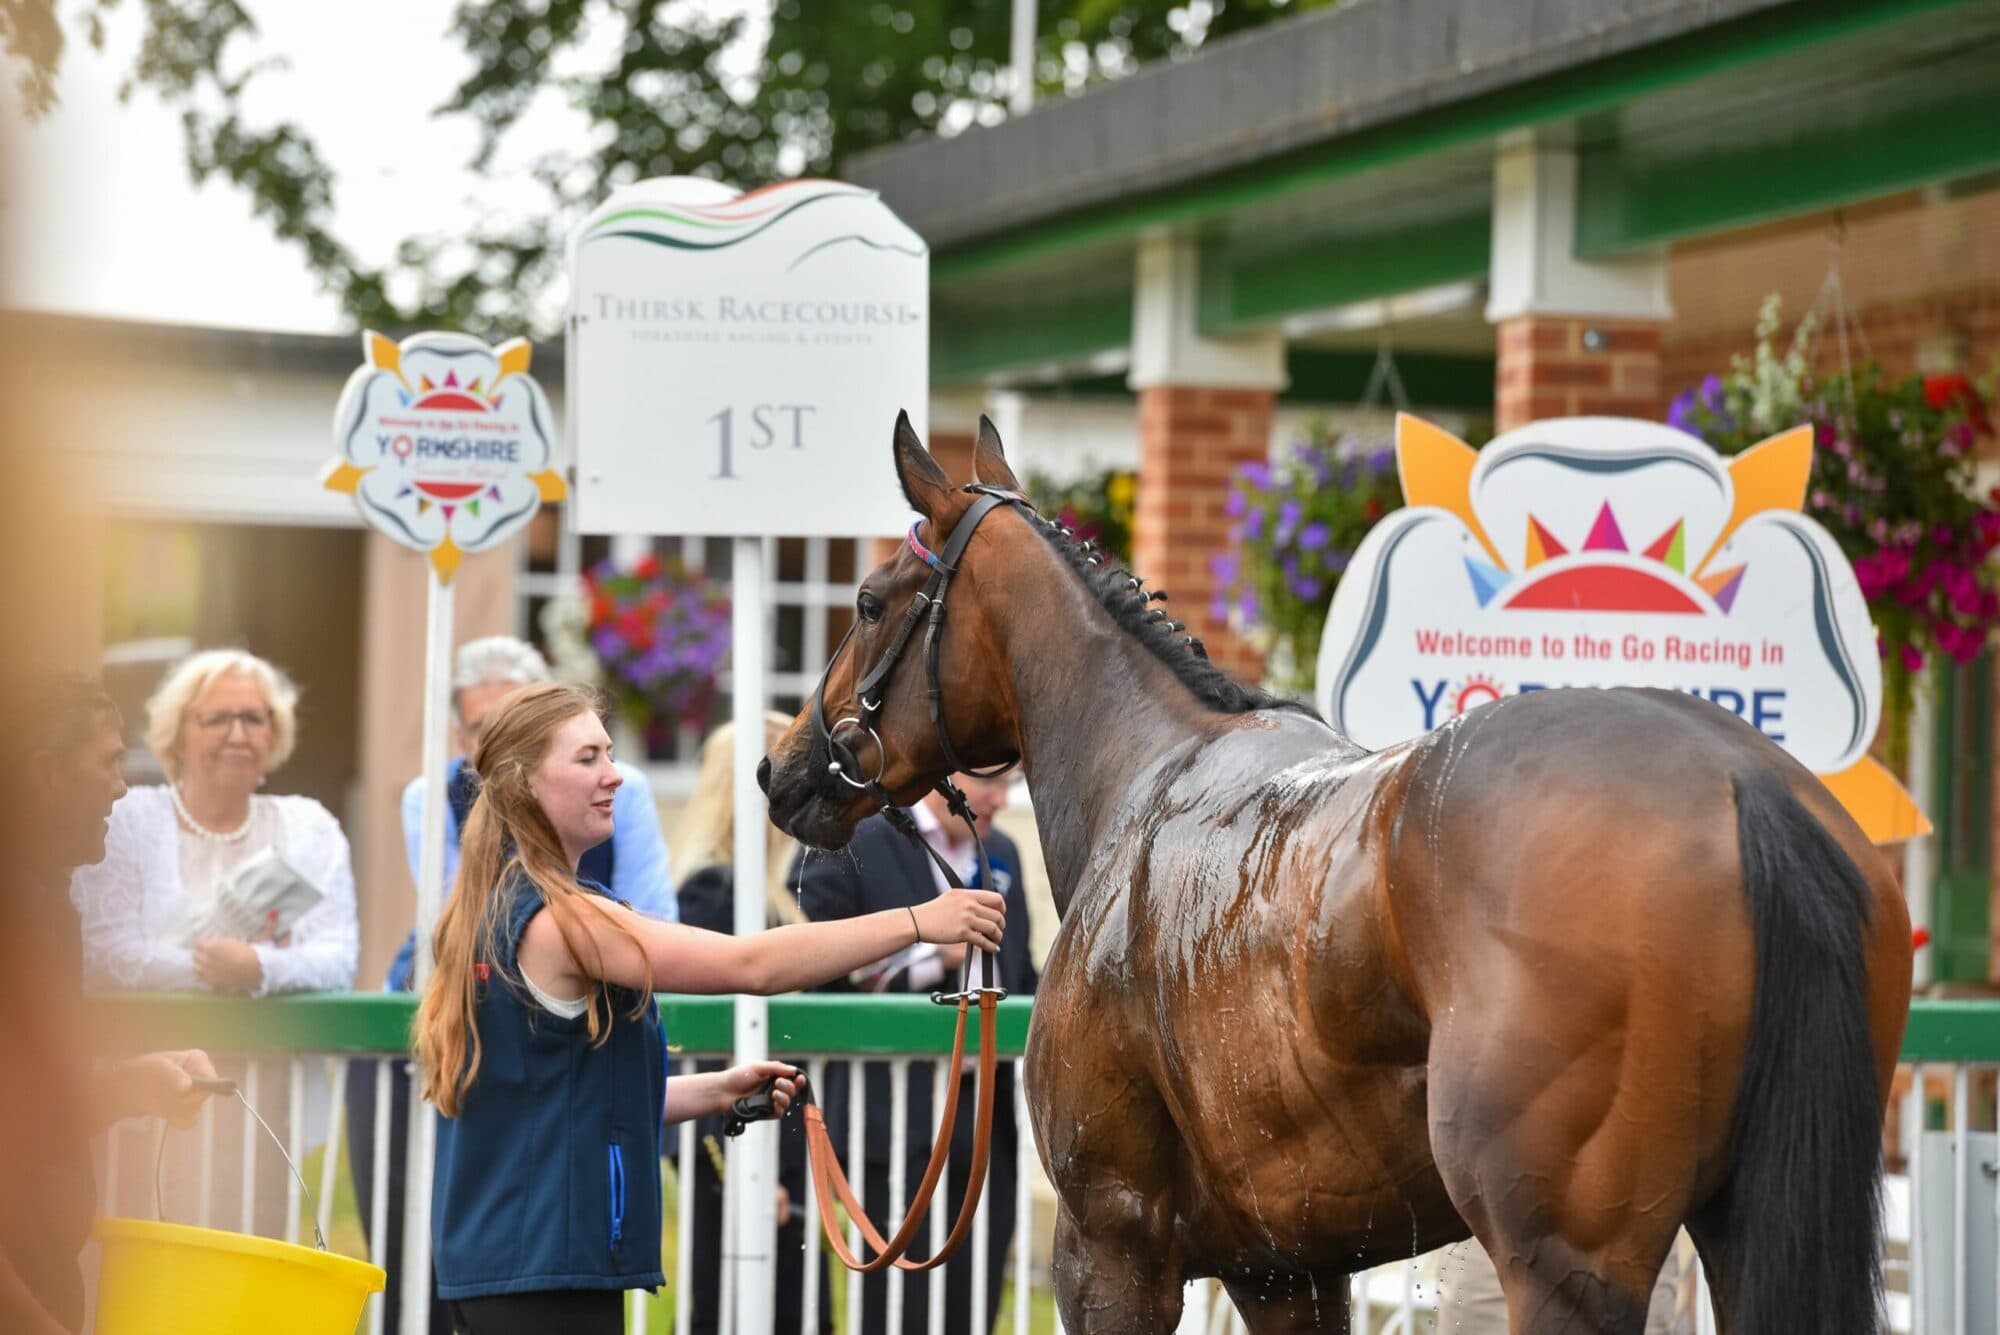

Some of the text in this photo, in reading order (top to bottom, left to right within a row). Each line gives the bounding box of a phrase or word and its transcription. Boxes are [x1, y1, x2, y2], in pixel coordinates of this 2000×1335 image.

[1415, 629, 1785, 668] Welcome to the Go Racing in
